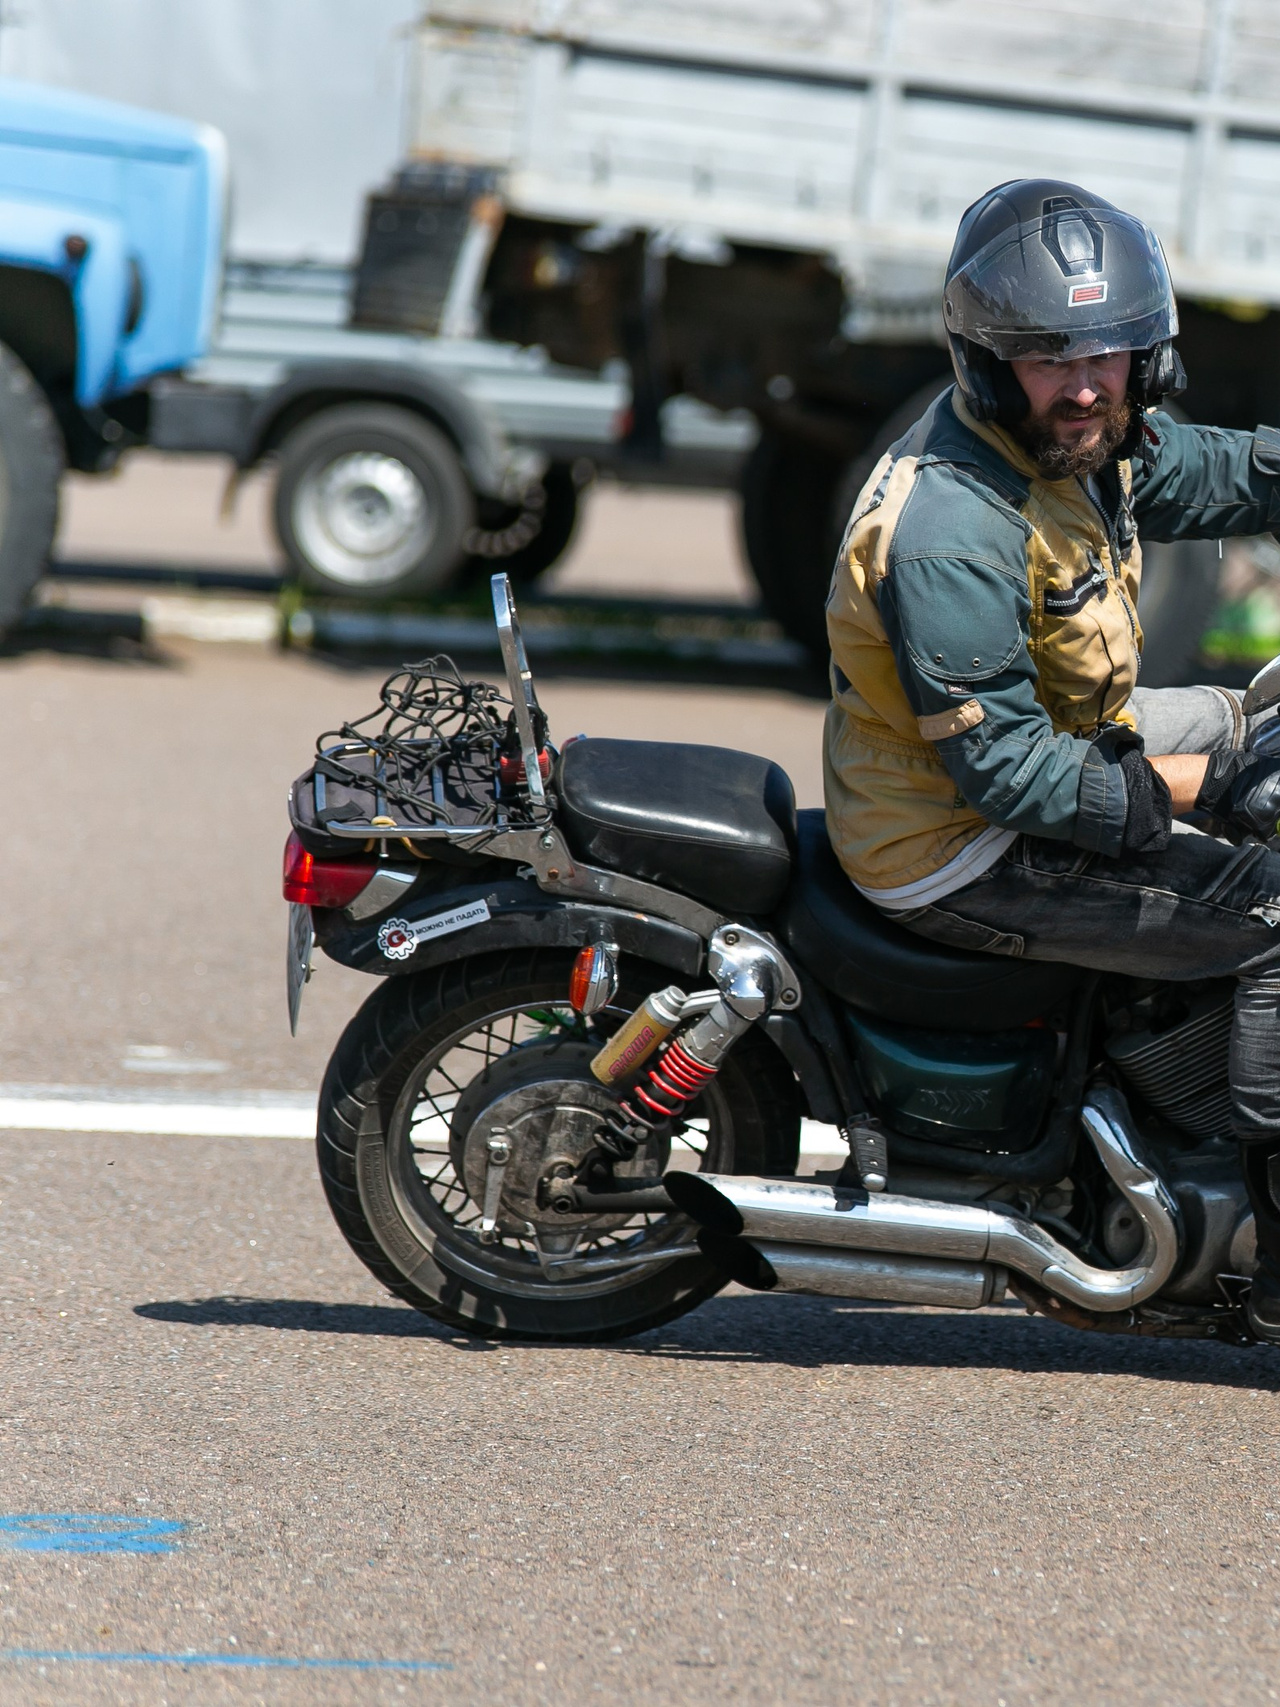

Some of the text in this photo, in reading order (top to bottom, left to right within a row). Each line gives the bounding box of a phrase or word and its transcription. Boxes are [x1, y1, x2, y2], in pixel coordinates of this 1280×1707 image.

[415, 907, 486, 935] МОЖНО НЕ ПАДАТЬ
[608, 1025, 656, 1076] SHOWA
